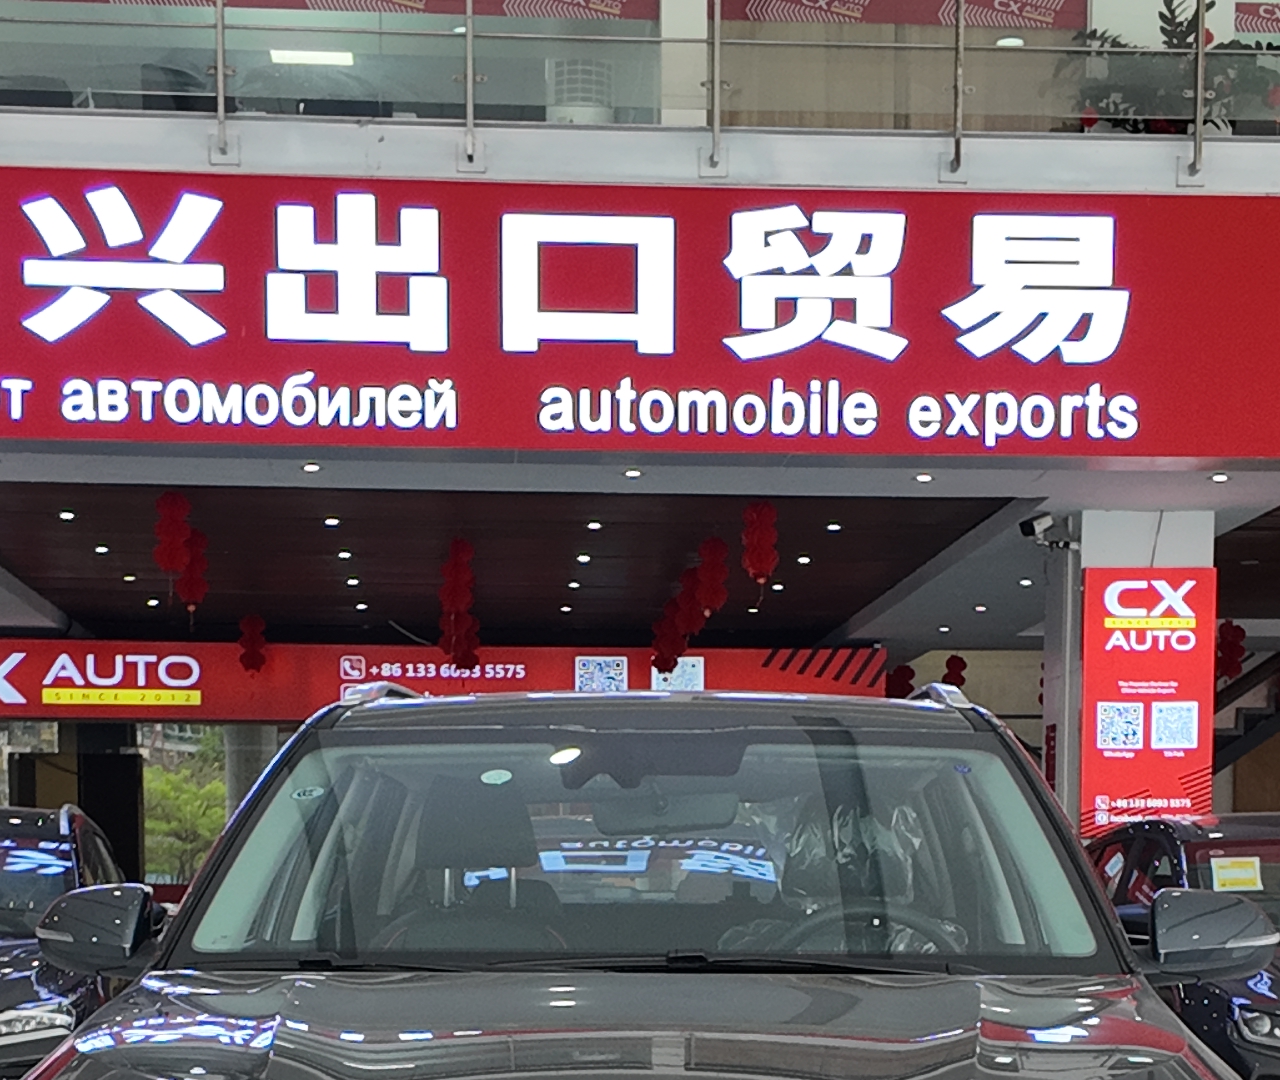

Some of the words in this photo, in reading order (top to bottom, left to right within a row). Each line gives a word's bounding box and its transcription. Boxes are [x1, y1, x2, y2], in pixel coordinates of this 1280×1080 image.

[61, 370, 459, 430] автомобилей
[537, 376, 879, 437] automobile
[907, 382, 1140, 447] exports
[1103, 580, 1197, 617] CX
[1104, 630, 1197, 651] AUTO
[41, 653, 202, 687] AUTO
[369, 663, 402, 677] +86
[405, 664, 436, 677] 133
[484, 664, 526, 678] 5575
[54, 692, 120, 702] SINCE
[139, 692, 192, 702] 2012
